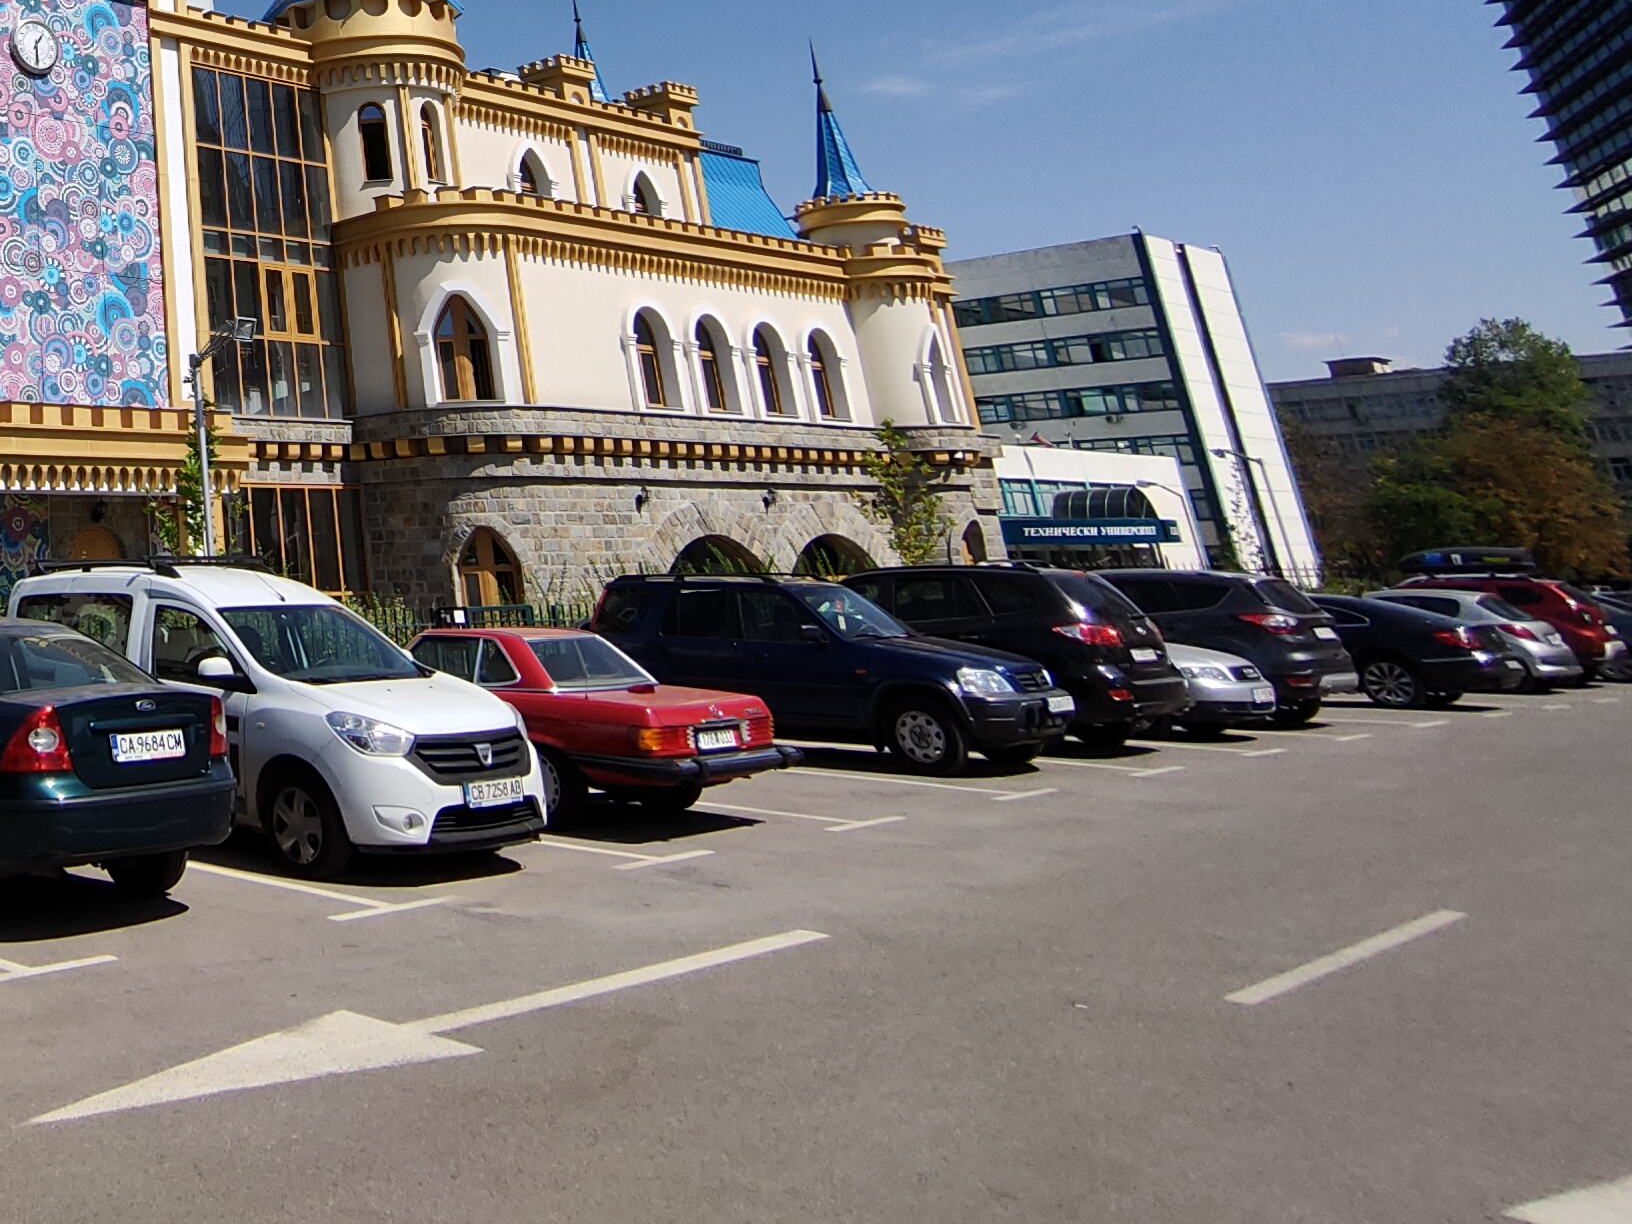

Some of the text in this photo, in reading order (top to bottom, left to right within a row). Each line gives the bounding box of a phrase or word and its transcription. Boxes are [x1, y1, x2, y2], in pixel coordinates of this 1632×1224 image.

[1022, 527, 1098, 537] ТЕХНИЧЕСКИ
[119, 737, 136, 754] CA
[136, 735, 165, 753] 9684
[167, 733, 183, 750] CM
[471, 780, 522, 801] CB 7258 AB
